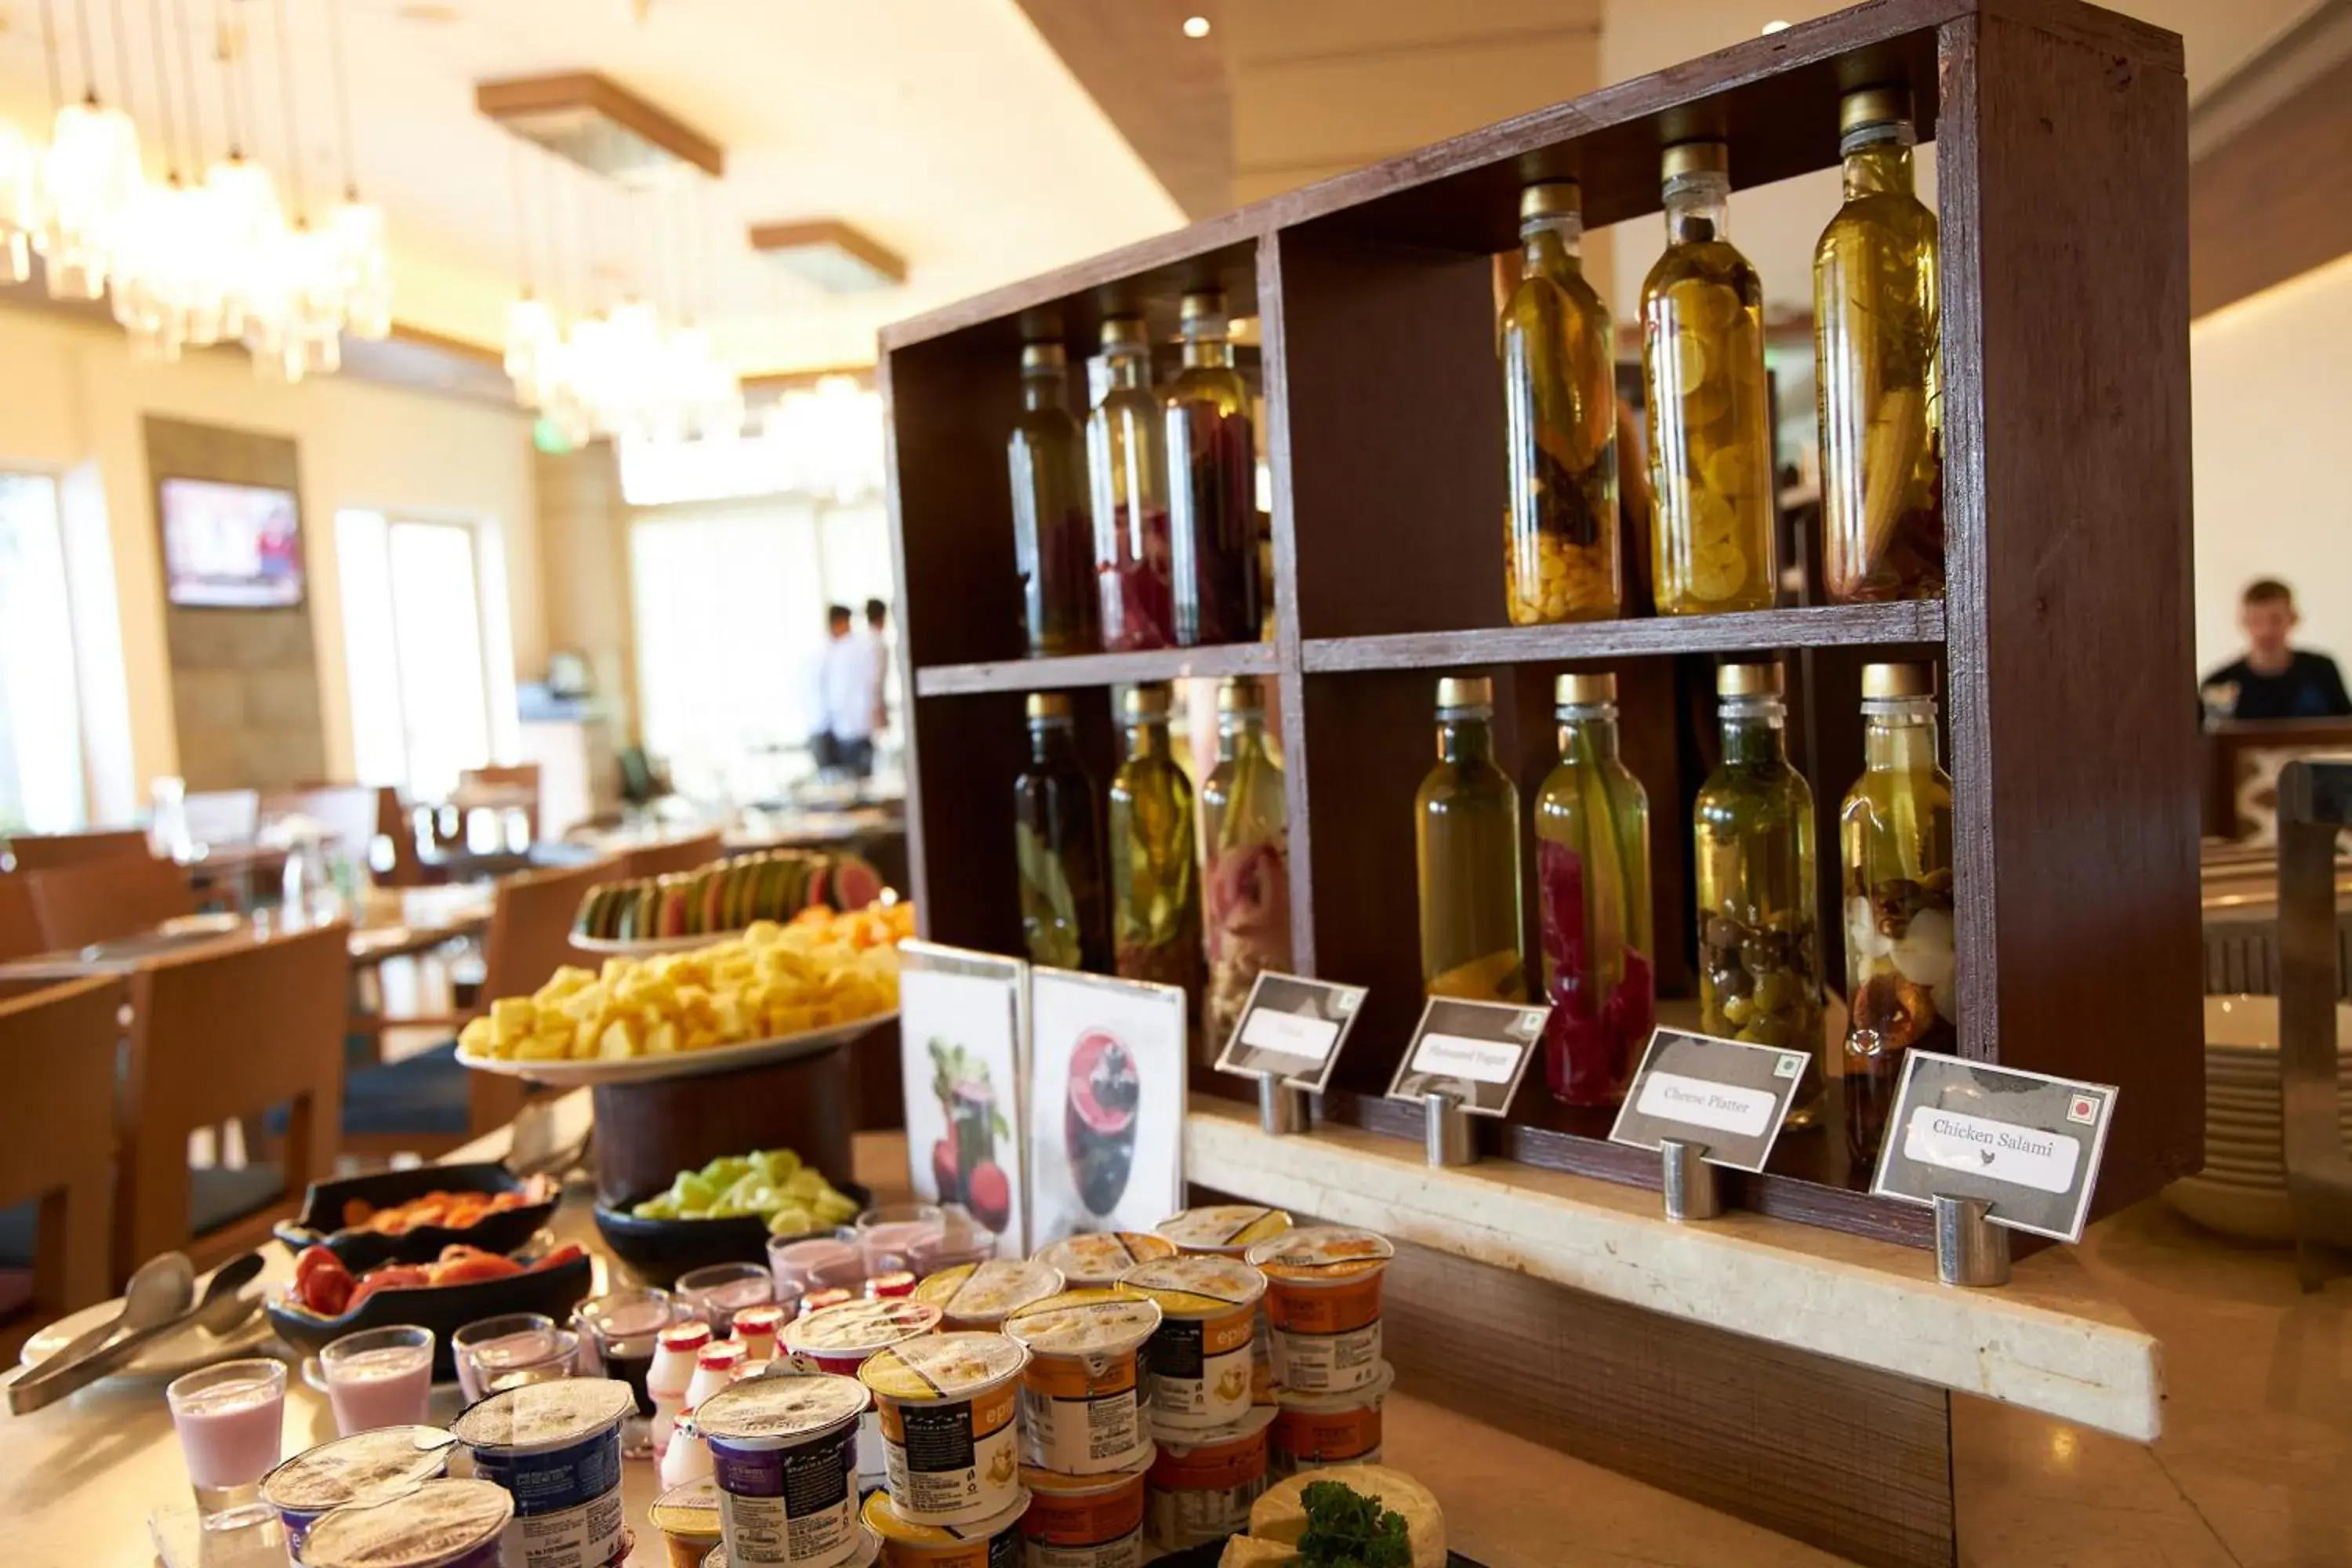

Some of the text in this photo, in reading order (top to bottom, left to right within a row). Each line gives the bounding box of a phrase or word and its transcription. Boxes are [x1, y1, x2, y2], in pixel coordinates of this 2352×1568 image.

[1708, 1094, 1751, 1113] Platter
[1933, 1119, 2054, 1157] Chicken Salami
